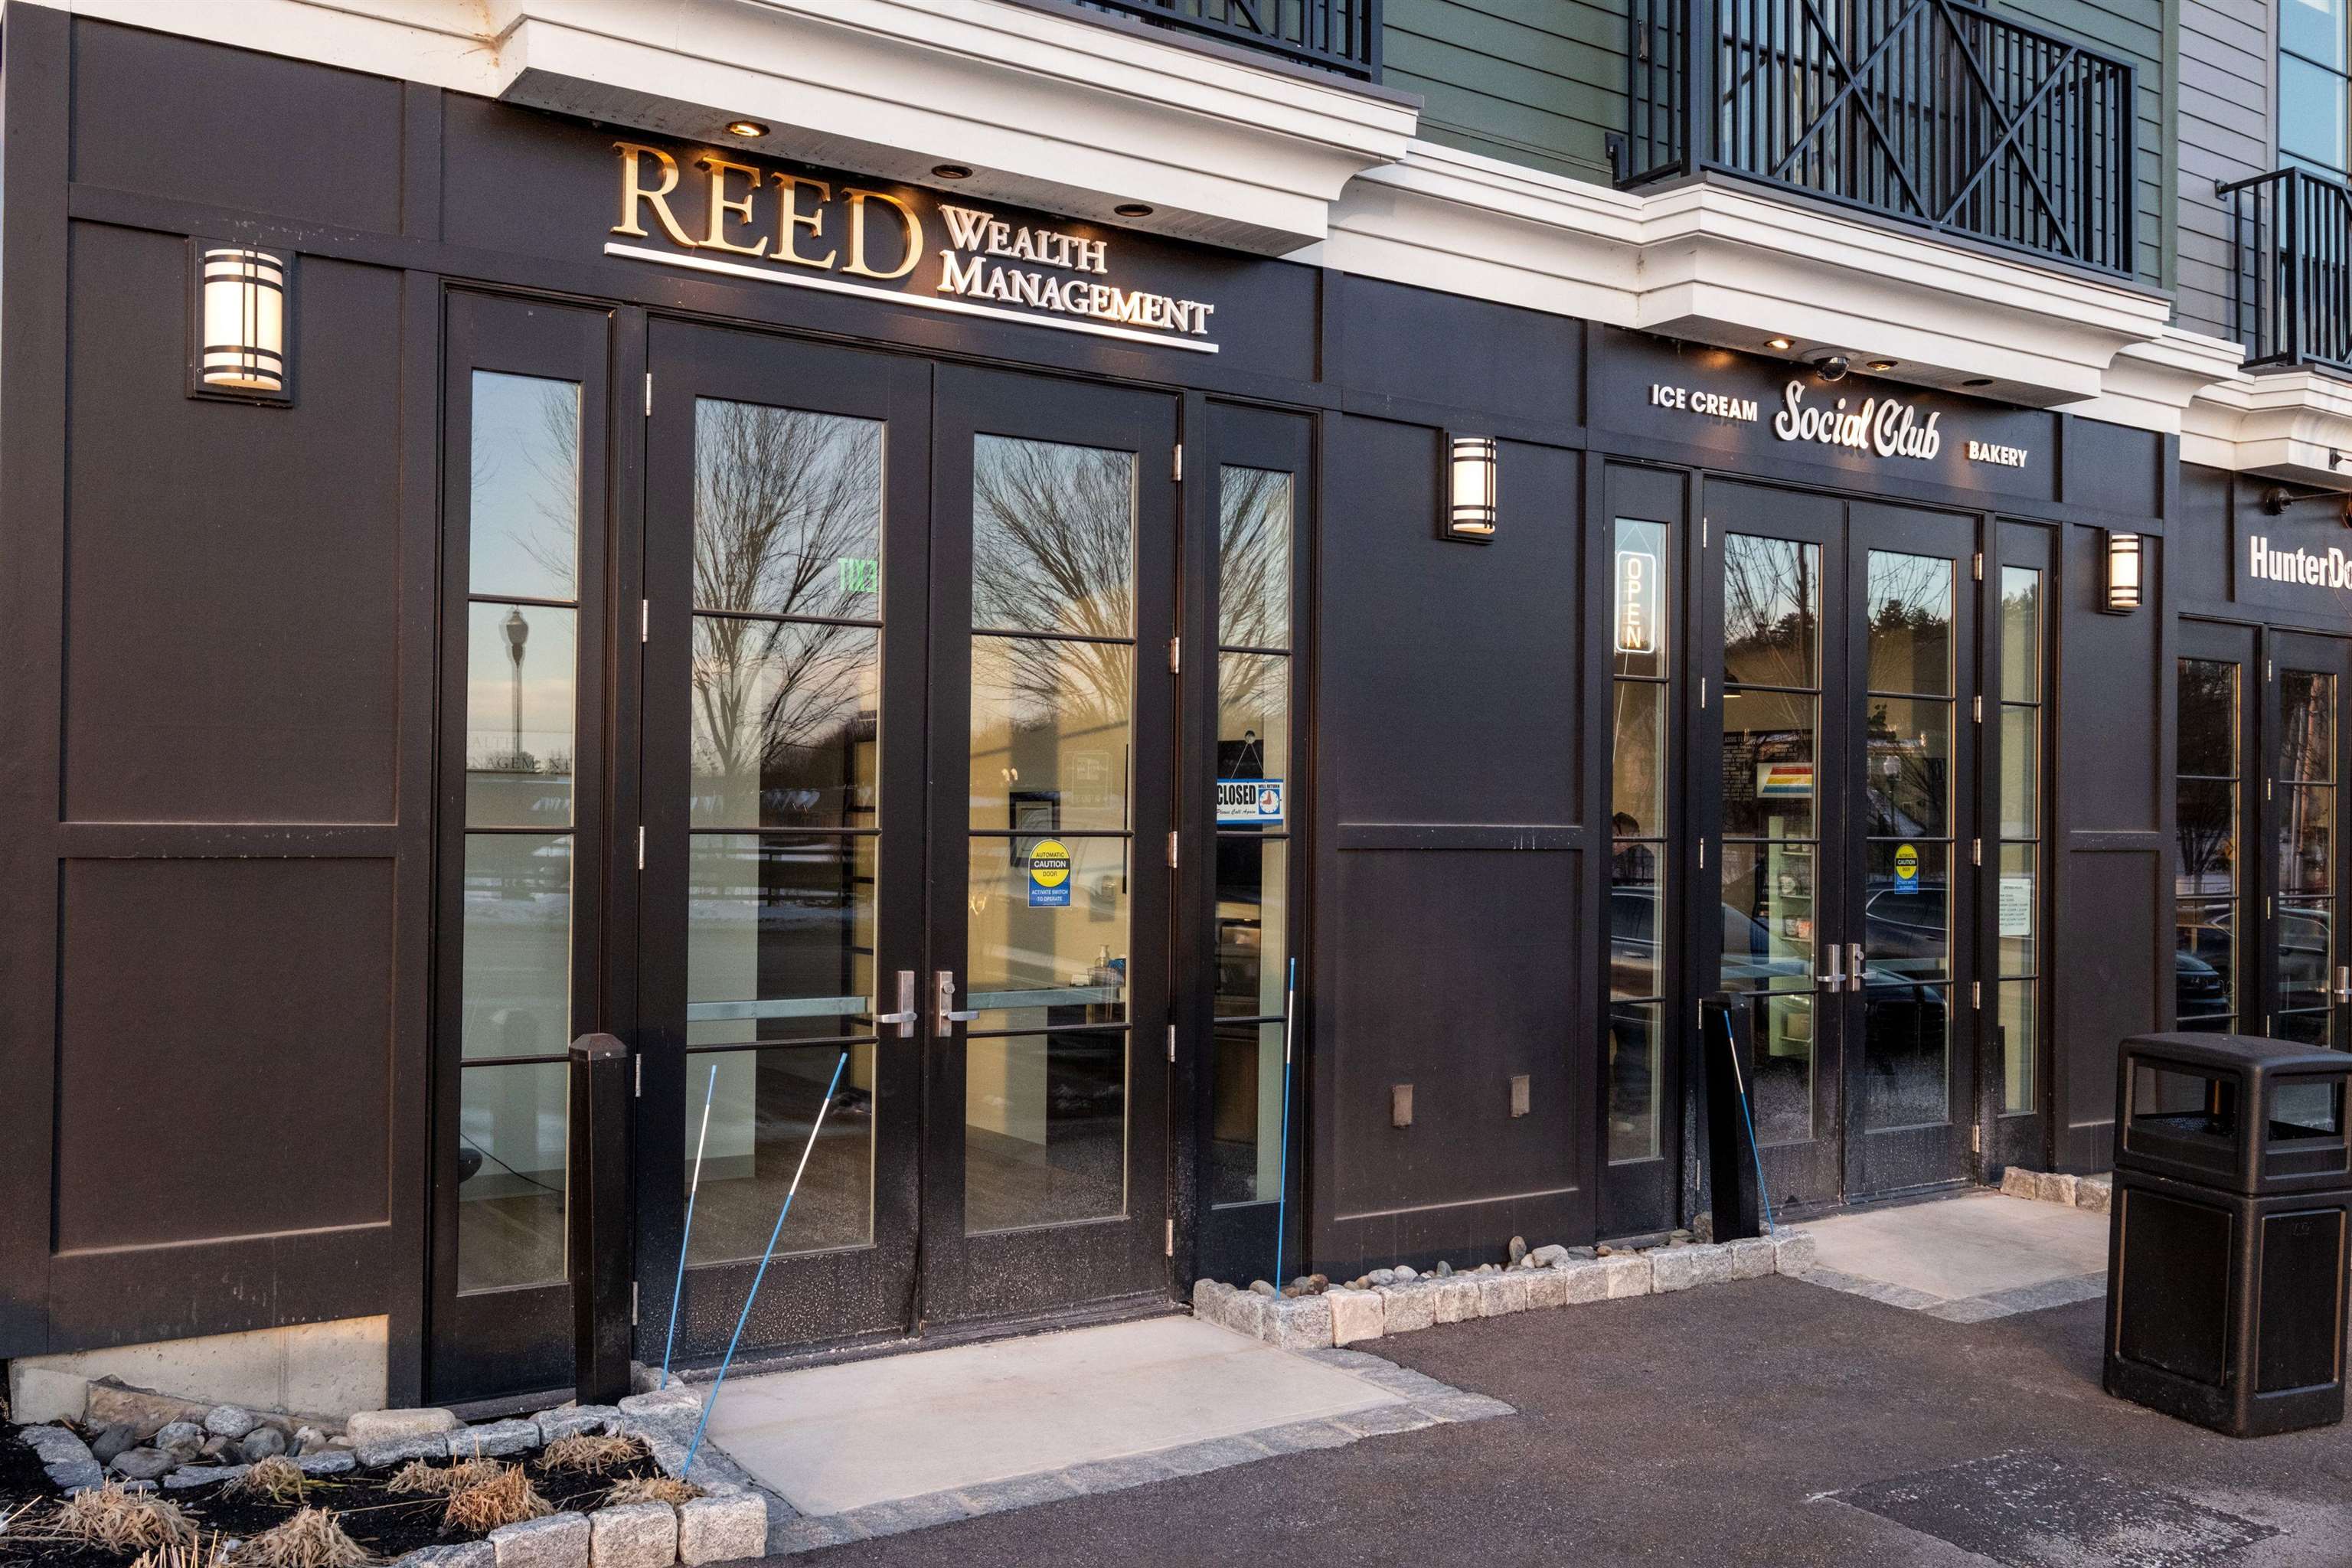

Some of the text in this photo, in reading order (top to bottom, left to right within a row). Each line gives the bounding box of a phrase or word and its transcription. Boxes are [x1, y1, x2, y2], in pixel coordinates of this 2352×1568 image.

[610, 141, 923, 279] REED
[938, 204, 1109, 274] WEALTH
[937, 250, 1214, 335] MANAGEMENT
[1652, 384, 1758, 422] ICE CREAM
[1775, 380, 1942, 459] Social Club
[1968, 440, 2028, 468] BAKERY
[1627, 557, 1642, 648] OPEN
[1217, 784, 1256, 805] CLOSED
